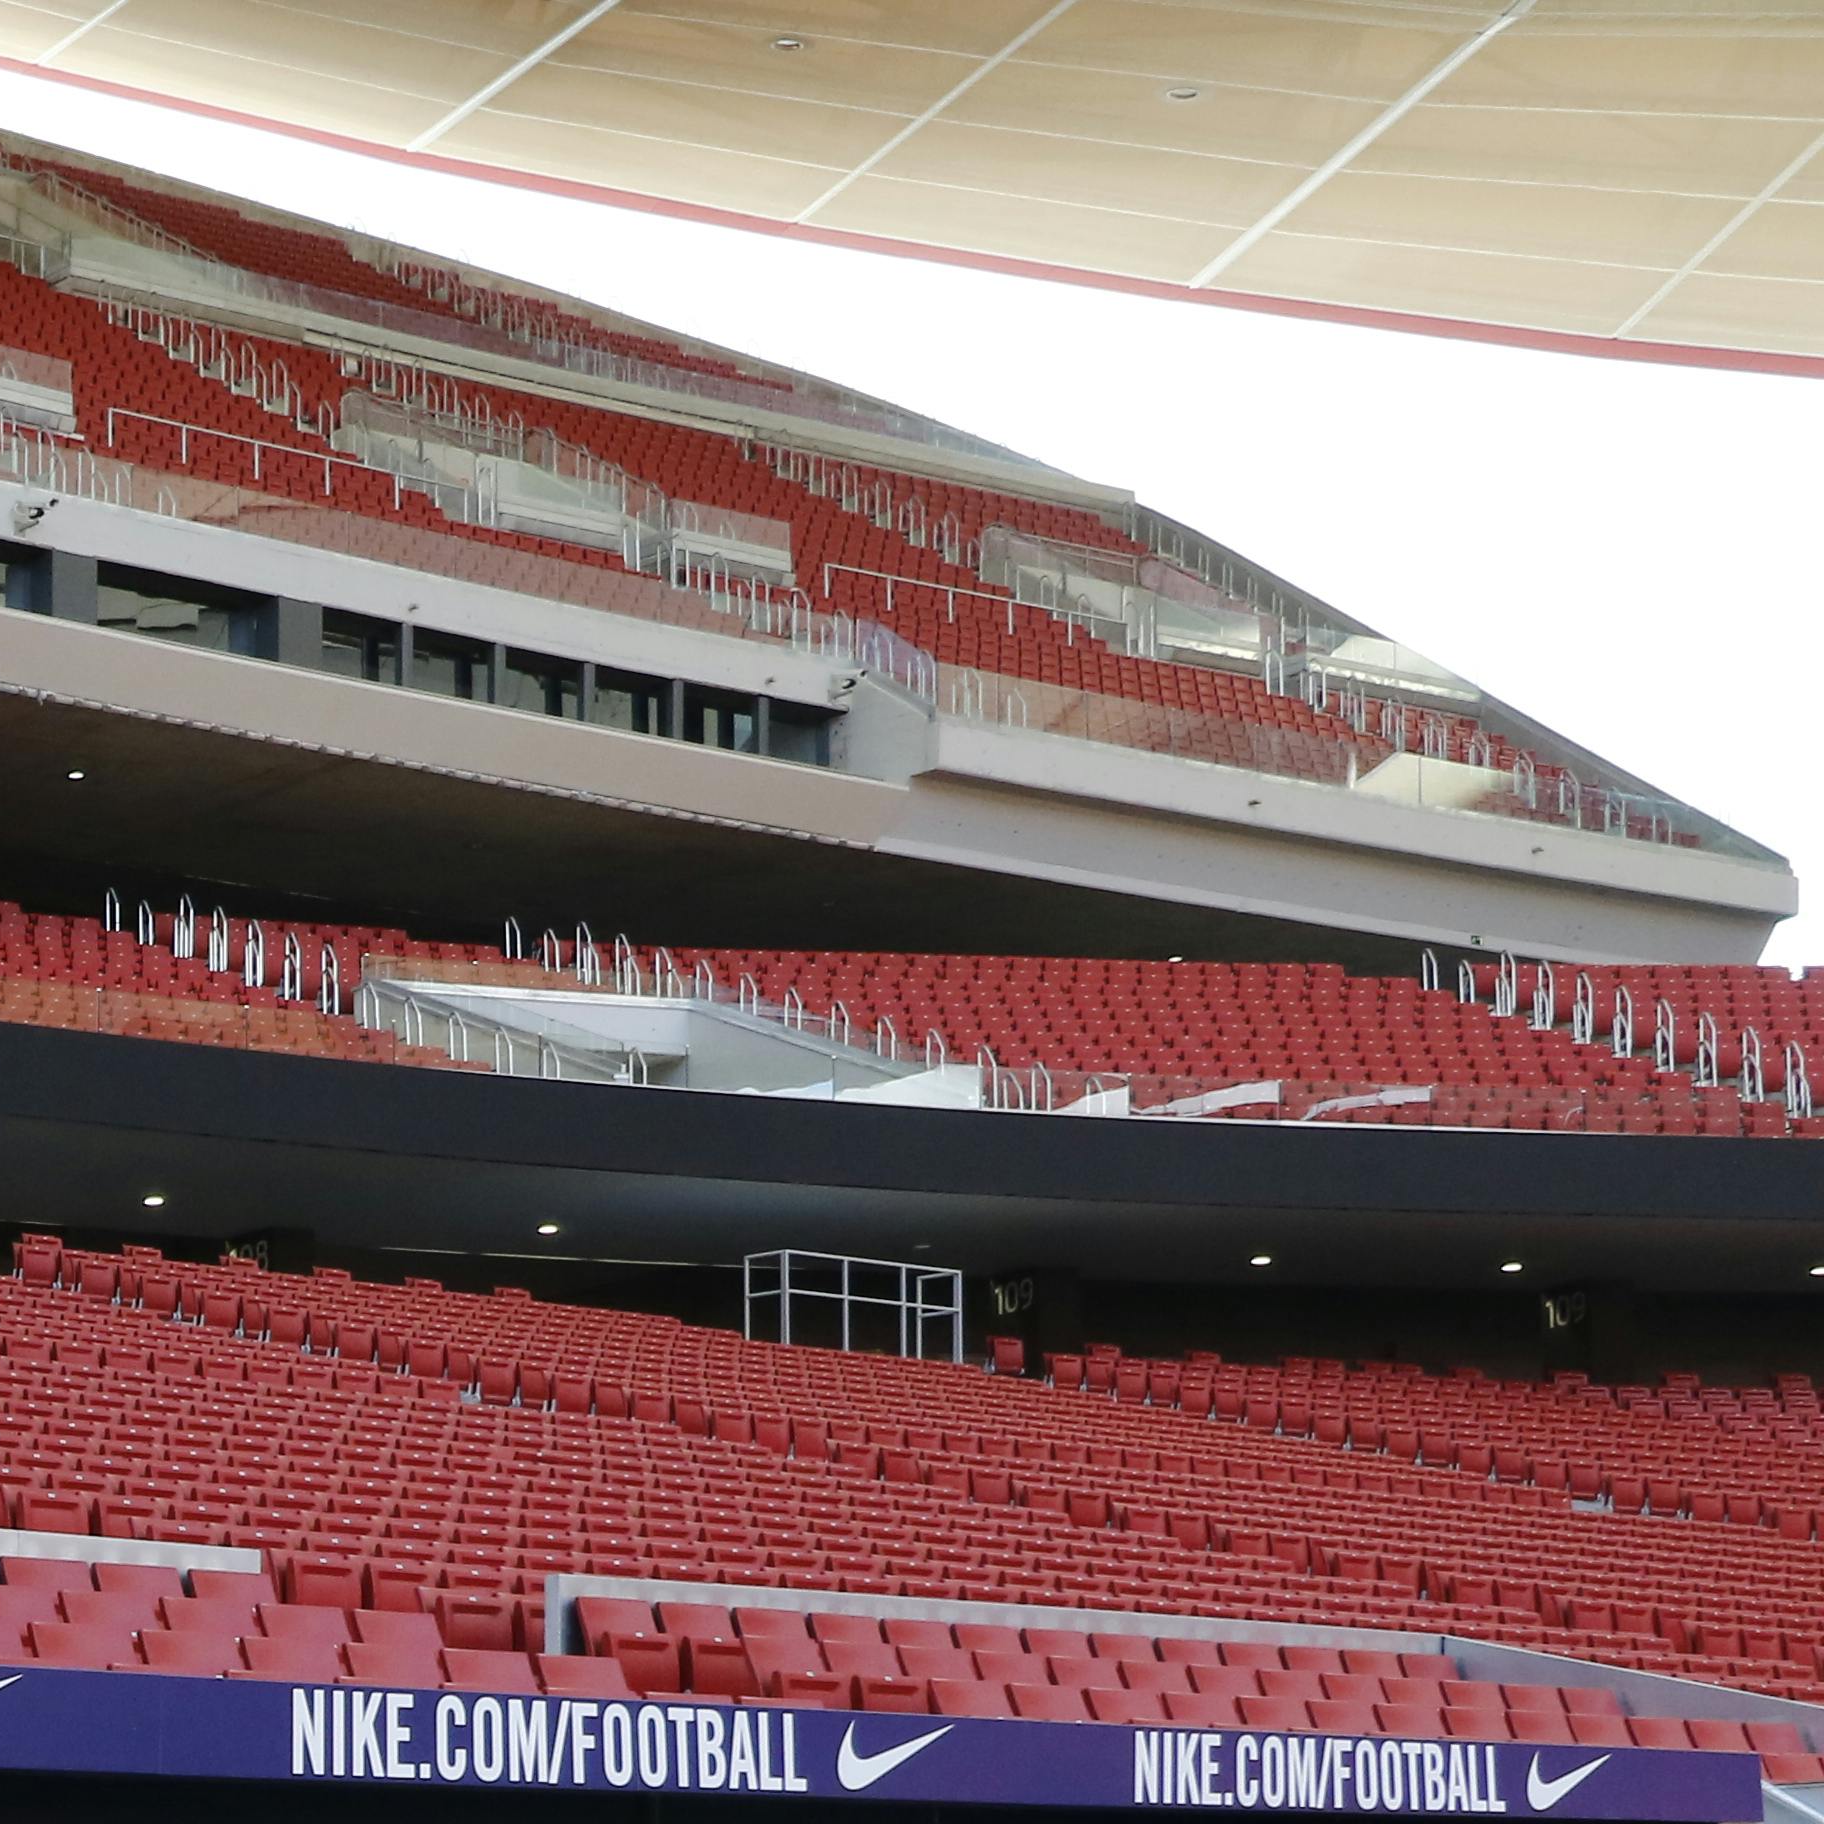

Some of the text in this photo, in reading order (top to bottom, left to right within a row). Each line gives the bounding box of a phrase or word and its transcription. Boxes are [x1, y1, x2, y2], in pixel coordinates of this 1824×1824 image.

[993, 1277, 1035, 1316] 109
[292, 1688, 808, 1792] NIKE.COM/FOOTBALL
[1134, 1730, 1507, 1812] NIKE.COM/FOOTBALL
